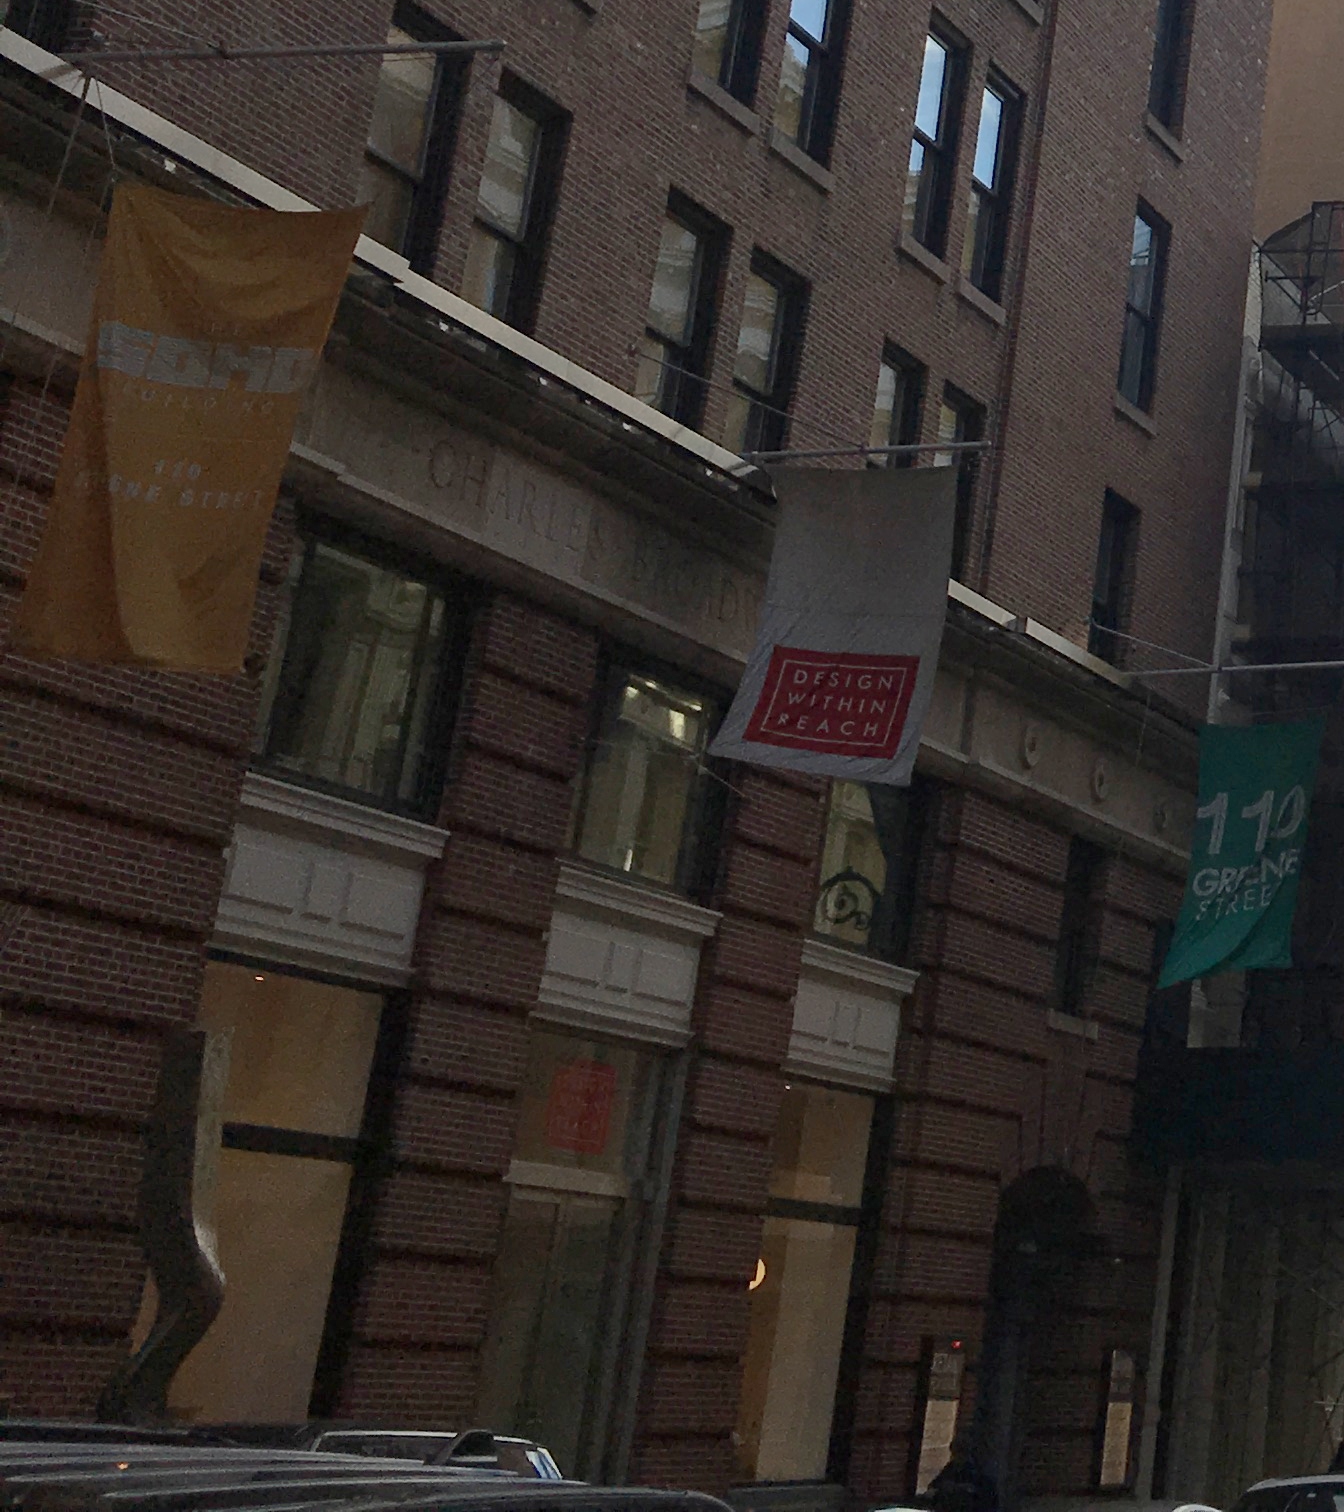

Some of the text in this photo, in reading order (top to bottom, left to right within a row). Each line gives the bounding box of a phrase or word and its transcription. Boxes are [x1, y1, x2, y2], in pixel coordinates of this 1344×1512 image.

[794, 669, 894, 691] DESIGN
[788, 692, 887, 714] WITHIN
[777, 713, 879, 737] REACH
[1196, 784, 1306, 855] 110
